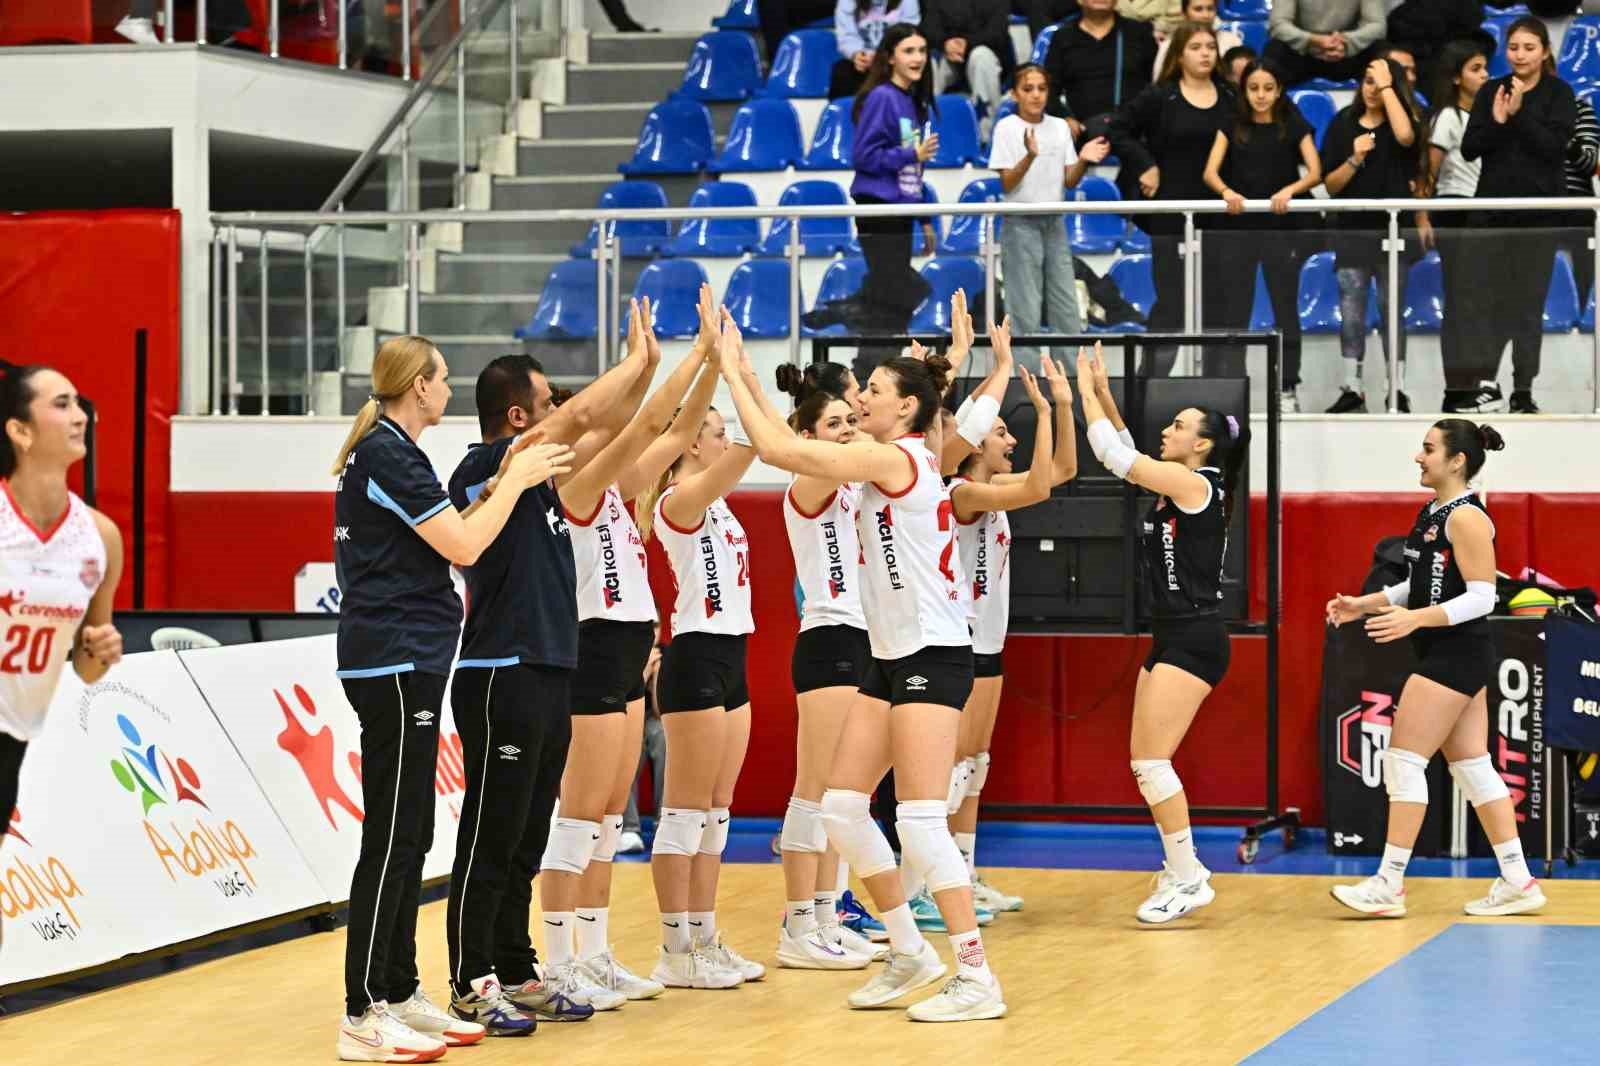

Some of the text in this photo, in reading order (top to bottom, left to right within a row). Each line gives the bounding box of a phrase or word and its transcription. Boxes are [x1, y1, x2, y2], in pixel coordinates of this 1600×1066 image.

[1431, 578, 1443, 606] KOL
[1, 624, 56, 674] 20
[1573, 697, 1600, 717] BEL
[1531, 664, 1544, 819] FIGHT EQUIPMENT
[143, 818, 257, 887] Adalya
[0, 855, 85, 929] dalya
